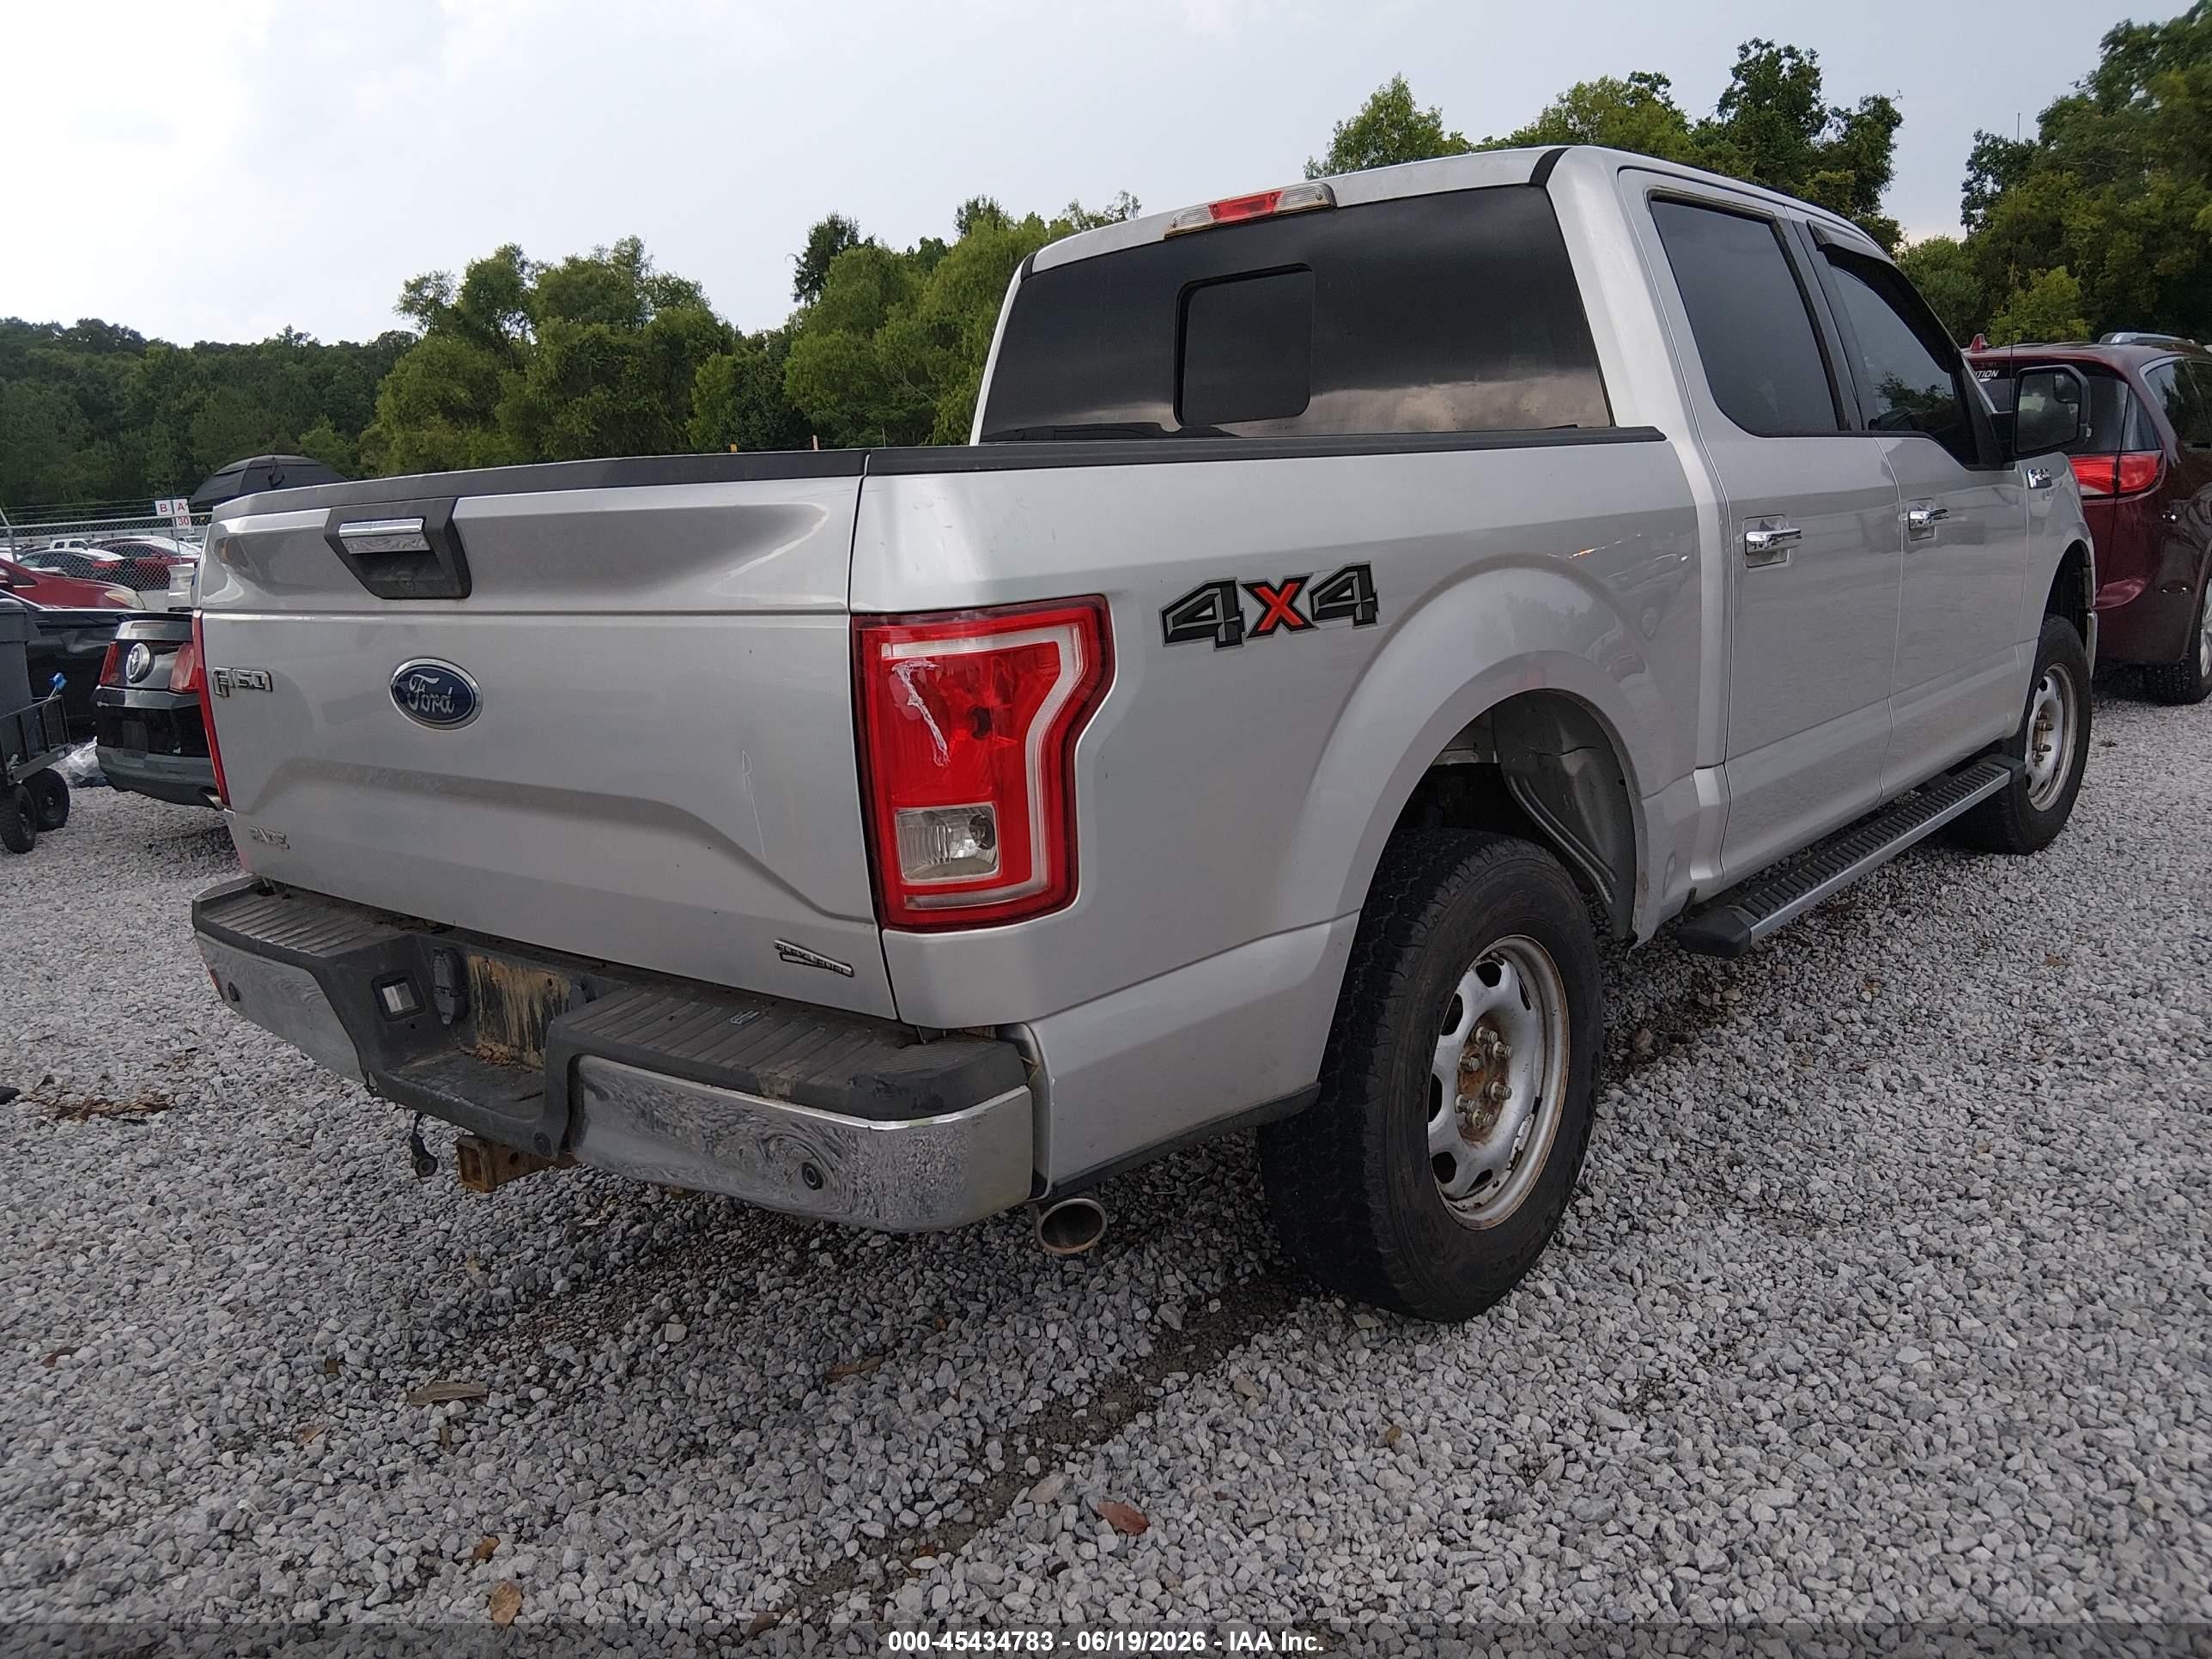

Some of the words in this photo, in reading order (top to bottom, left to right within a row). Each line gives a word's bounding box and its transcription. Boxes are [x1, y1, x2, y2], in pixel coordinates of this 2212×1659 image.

[160, 503, 168, 513] B
[177, 502, 185, 511] A
[407, 673, 455, 714] Ford
